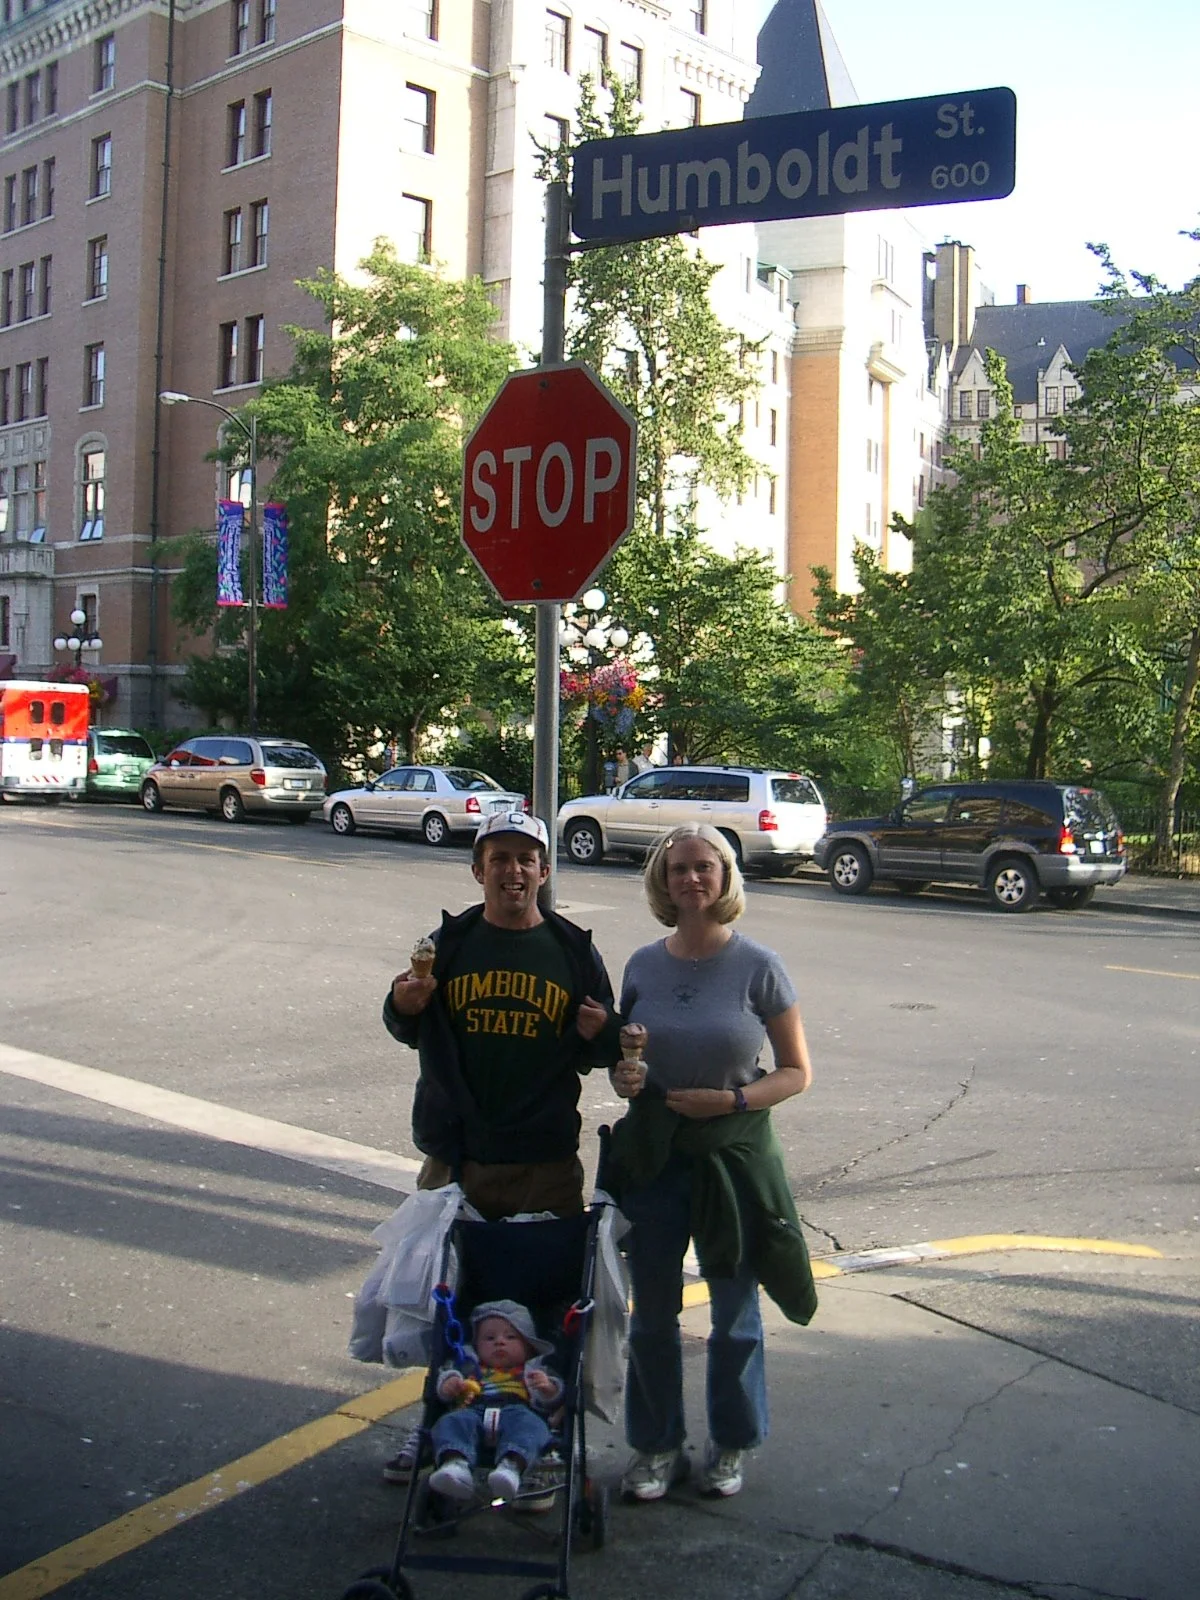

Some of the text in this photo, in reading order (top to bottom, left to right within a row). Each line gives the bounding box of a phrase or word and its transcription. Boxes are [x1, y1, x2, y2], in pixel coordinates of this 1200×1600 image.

[591, 101, 985, 220] Humboldt St.
[931, 161, 990, 190] 600
[470, 437, 622, 532] STOP
[466, 1008, 540, 1038] STATE
